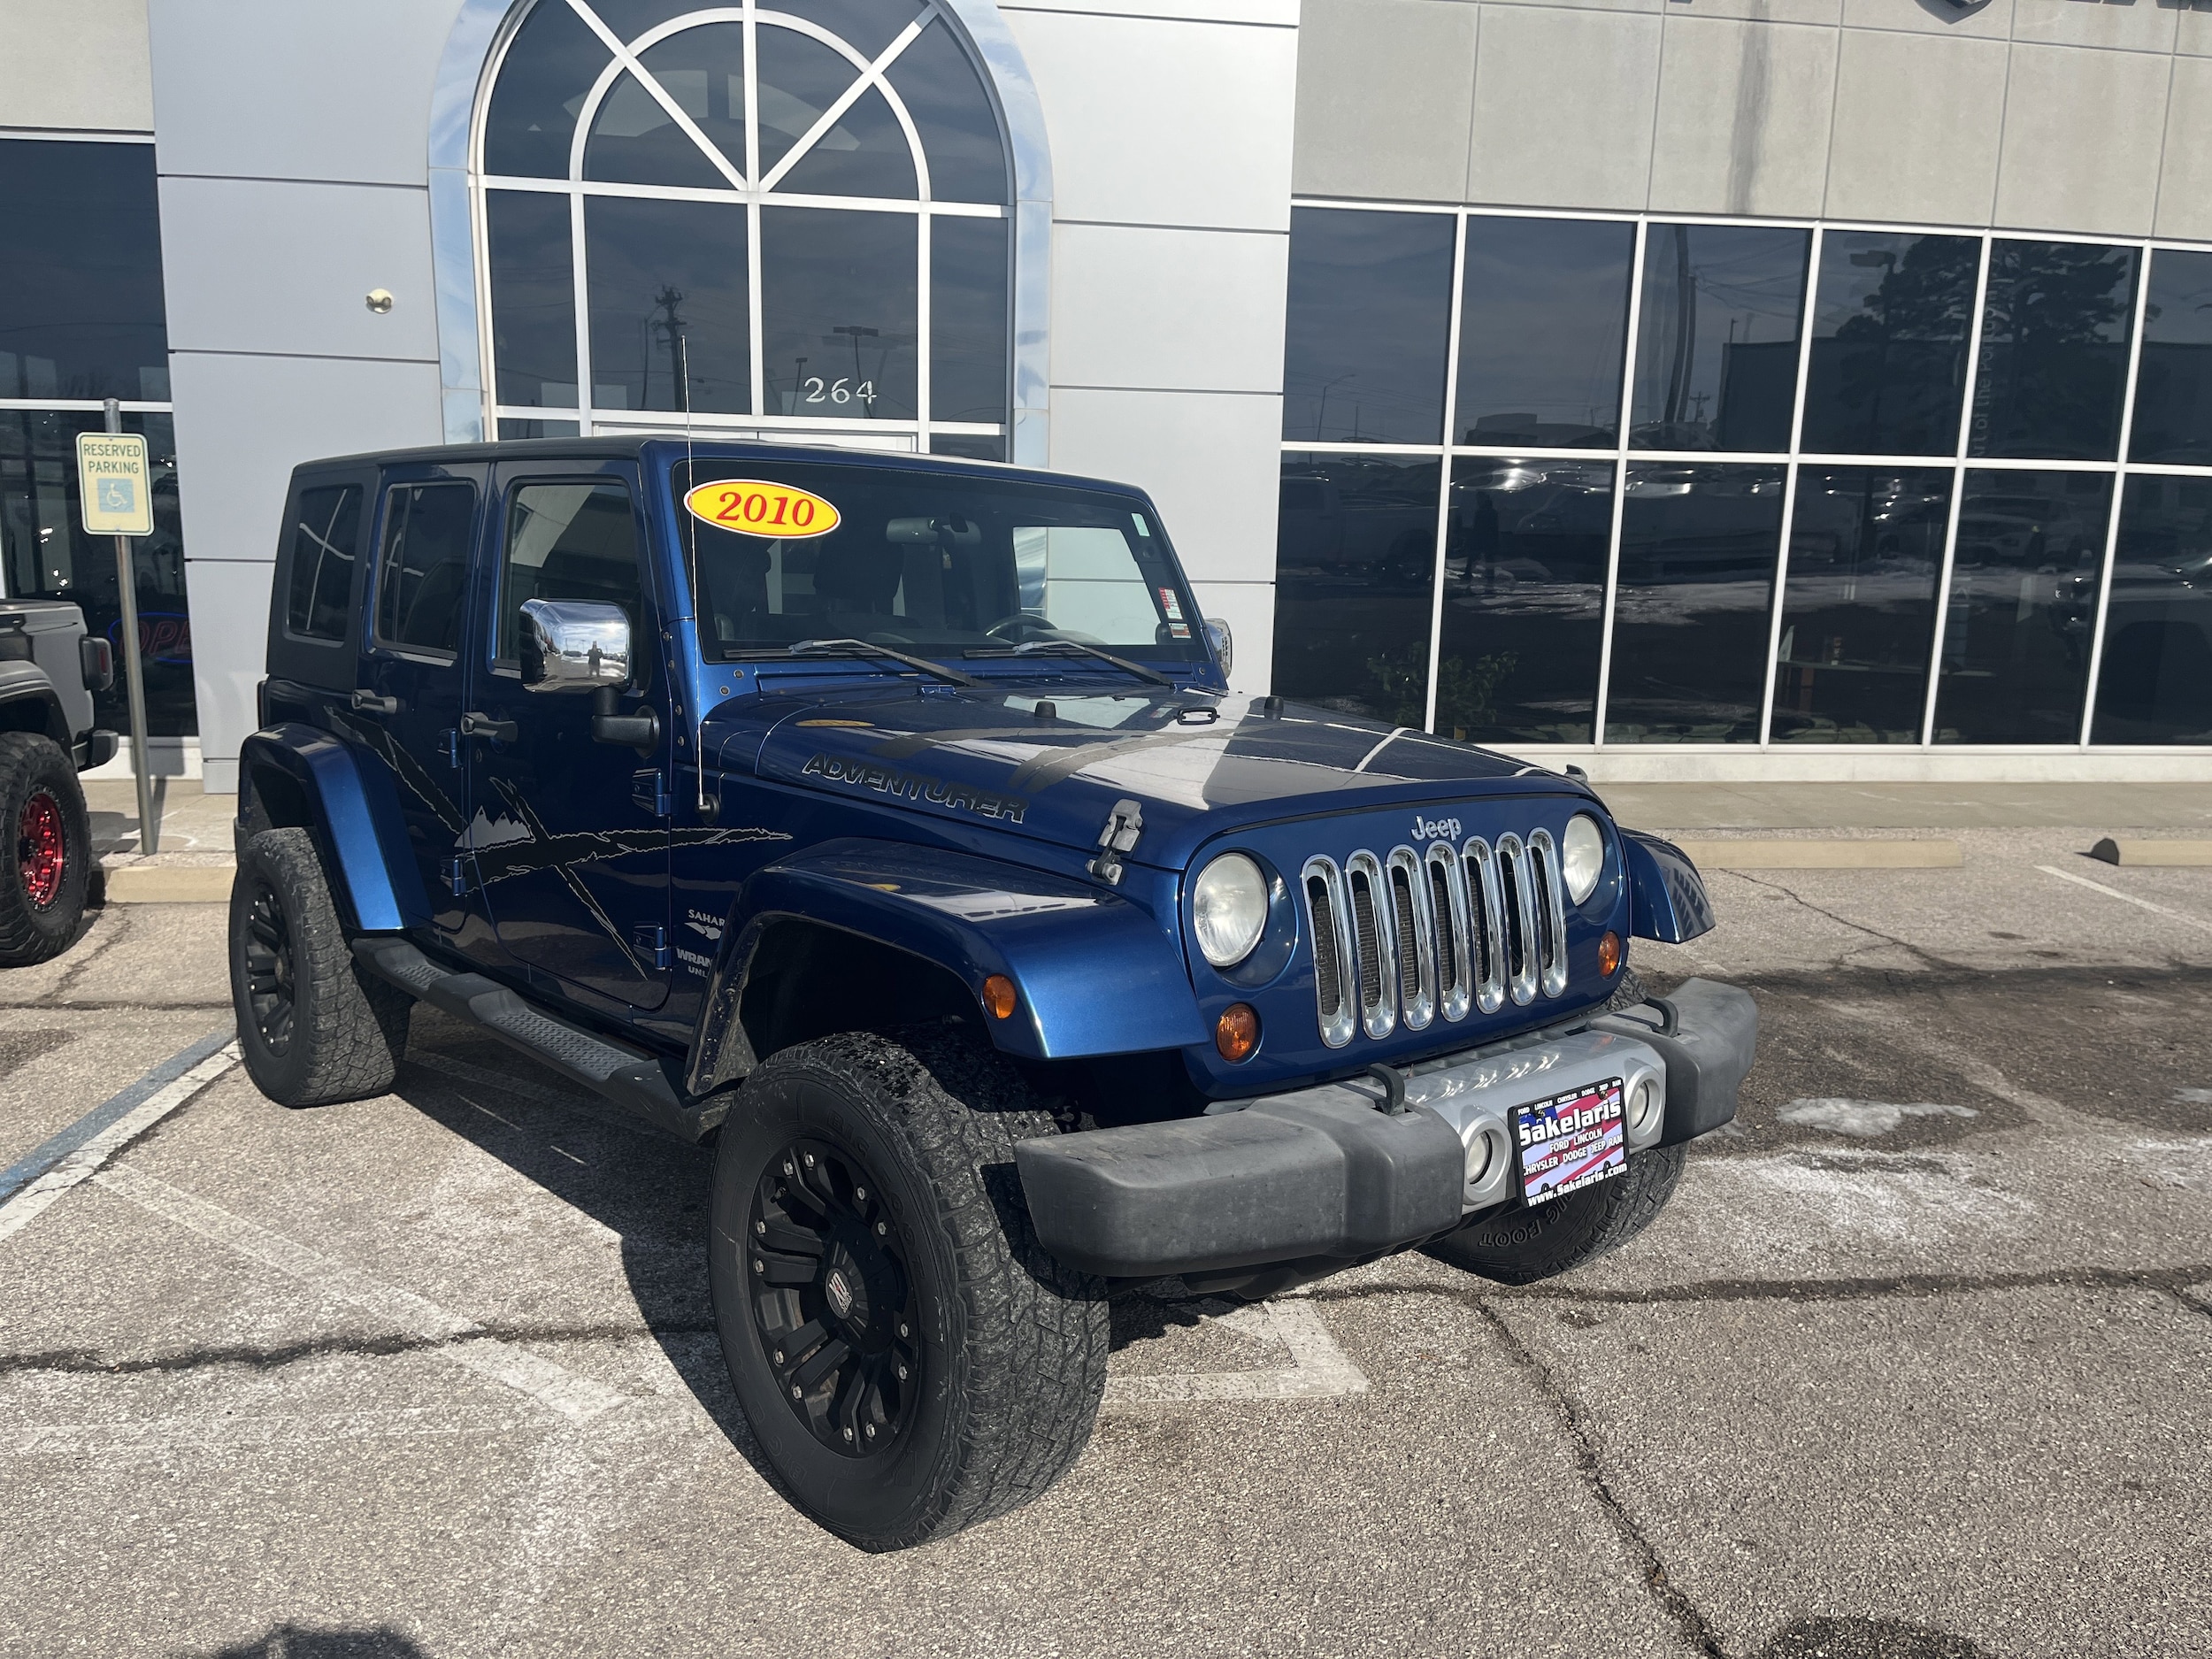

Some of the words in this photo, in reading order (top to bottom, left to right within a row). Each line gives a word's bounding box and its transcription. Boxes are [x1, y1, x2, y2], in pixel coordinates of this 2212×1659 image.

[803, 377, 878, 404] 264
[83, 443, 142, 457] RESERVED
[88, 460, 140, 474] PARKING
[716, 491, 815, 526] 2010
[801, 752, 1030, 825] ADVENTURER
[1410, 815, 1462, 841] Jeep
[1517, 1106, 1531, 1116] FORD
[1533, 1099, 1553, 1110] LINCOLN
[1556, 1092, 1578, 1104] CHRYSLER
[1581, 1087, 1596, 1097] DODGE
[1599, 1082, 1609, 1091] JEEP
[1612, 1079, 1622, 1087] RAM
[1518, 1100, 1621, 1147] Sakelaris
[1549, 1139, 1571, 1154] FORD
[1573, 1127, 1603, 1146] LINCOLN
[1563, 1146, 1588, 1164] DODGE
[1590, 1140, 1607, 1154] JEEP
[1609, 1134, 1624, 1148] RAM
[1527, 1163, 1629, 1208] www.Sakelaris.com
[1479, 1218, 1542, 1248] FOOT
